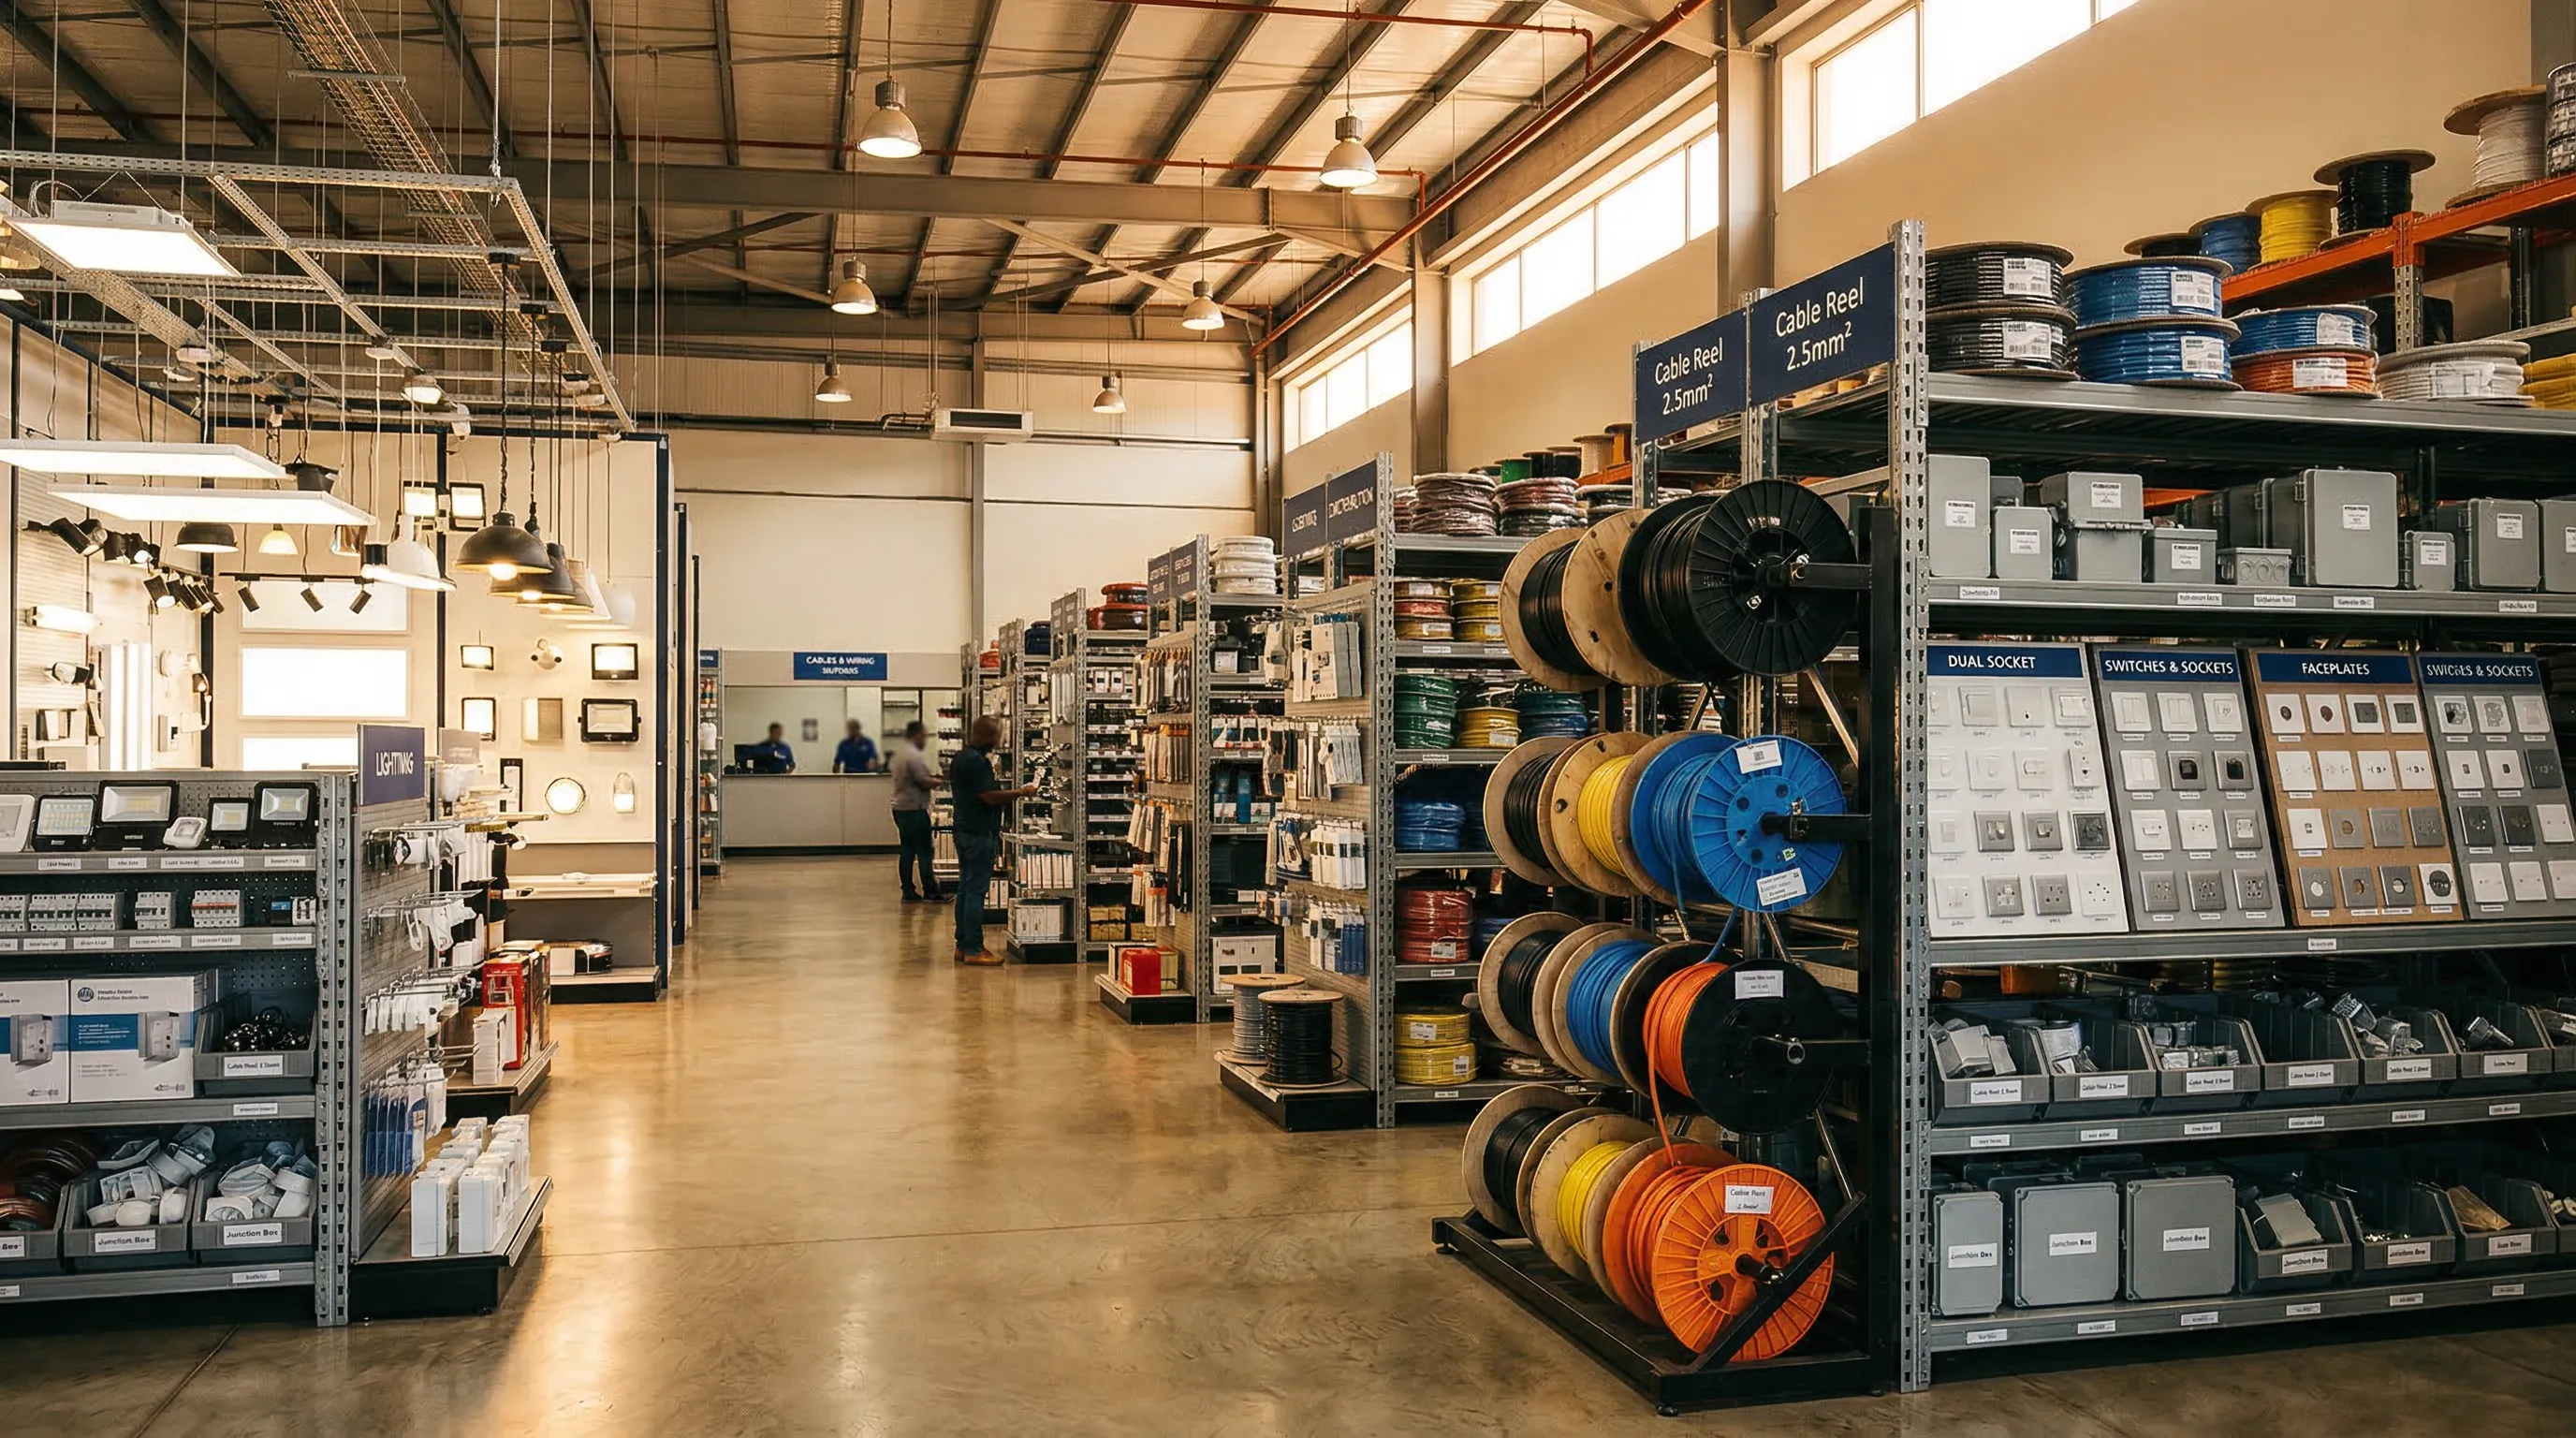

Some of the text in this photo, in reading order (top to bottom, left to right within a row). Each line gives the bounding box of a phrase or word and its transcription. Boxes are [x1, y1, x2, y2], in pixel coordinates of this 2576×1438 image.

[1776, 276, 1864, 337] Cable Reel
[1655, 337, 1722, 385] Cable Reel
[1948, 654, 2036, 668] DUAL SOCKET
[2105, 659, 2234, 674] SWITCHES & SOCKETS
[2302, 662, 2370, 675] FACEPLATES
[2476, 665, 2484, 676] &
[2486, 665, 2534, 677] SOCKETS
